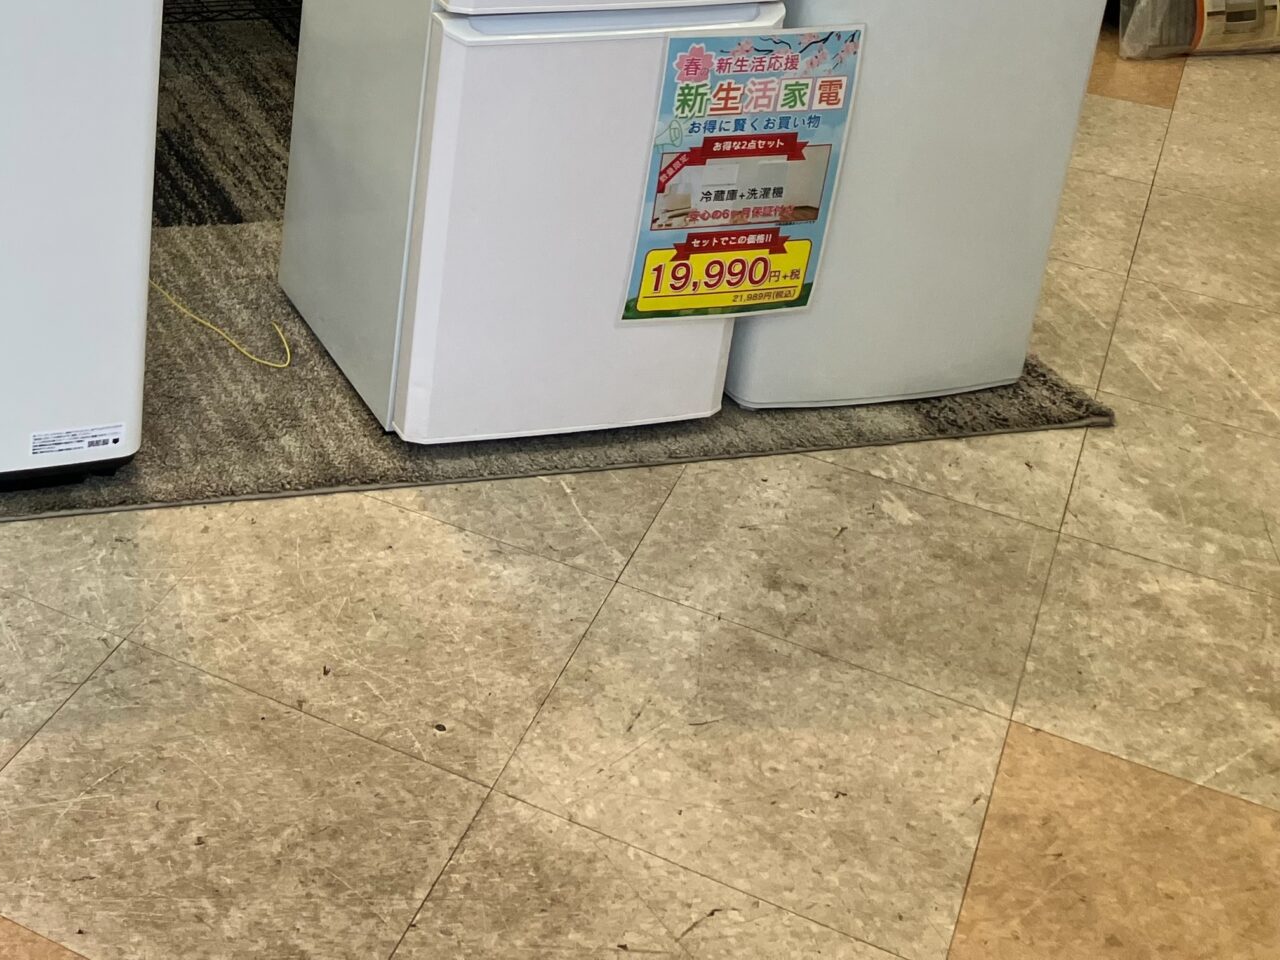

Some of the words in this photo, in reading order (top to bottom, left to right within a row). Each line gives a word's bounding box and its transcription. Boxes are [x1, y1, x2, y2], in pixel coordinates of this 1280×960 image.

[716, 54, 800, 73] 新生活応援
[675, 79, 843, 117] 新生活家電
[688, 114, 821, 134] お得に賢くお買い物
[712, 139, 785, 152] お得な2点セット
[699, 187, 784, 202] 冷蔵庫+洗濯機
[691, 234, 772, 247] セットでこの価格!!
